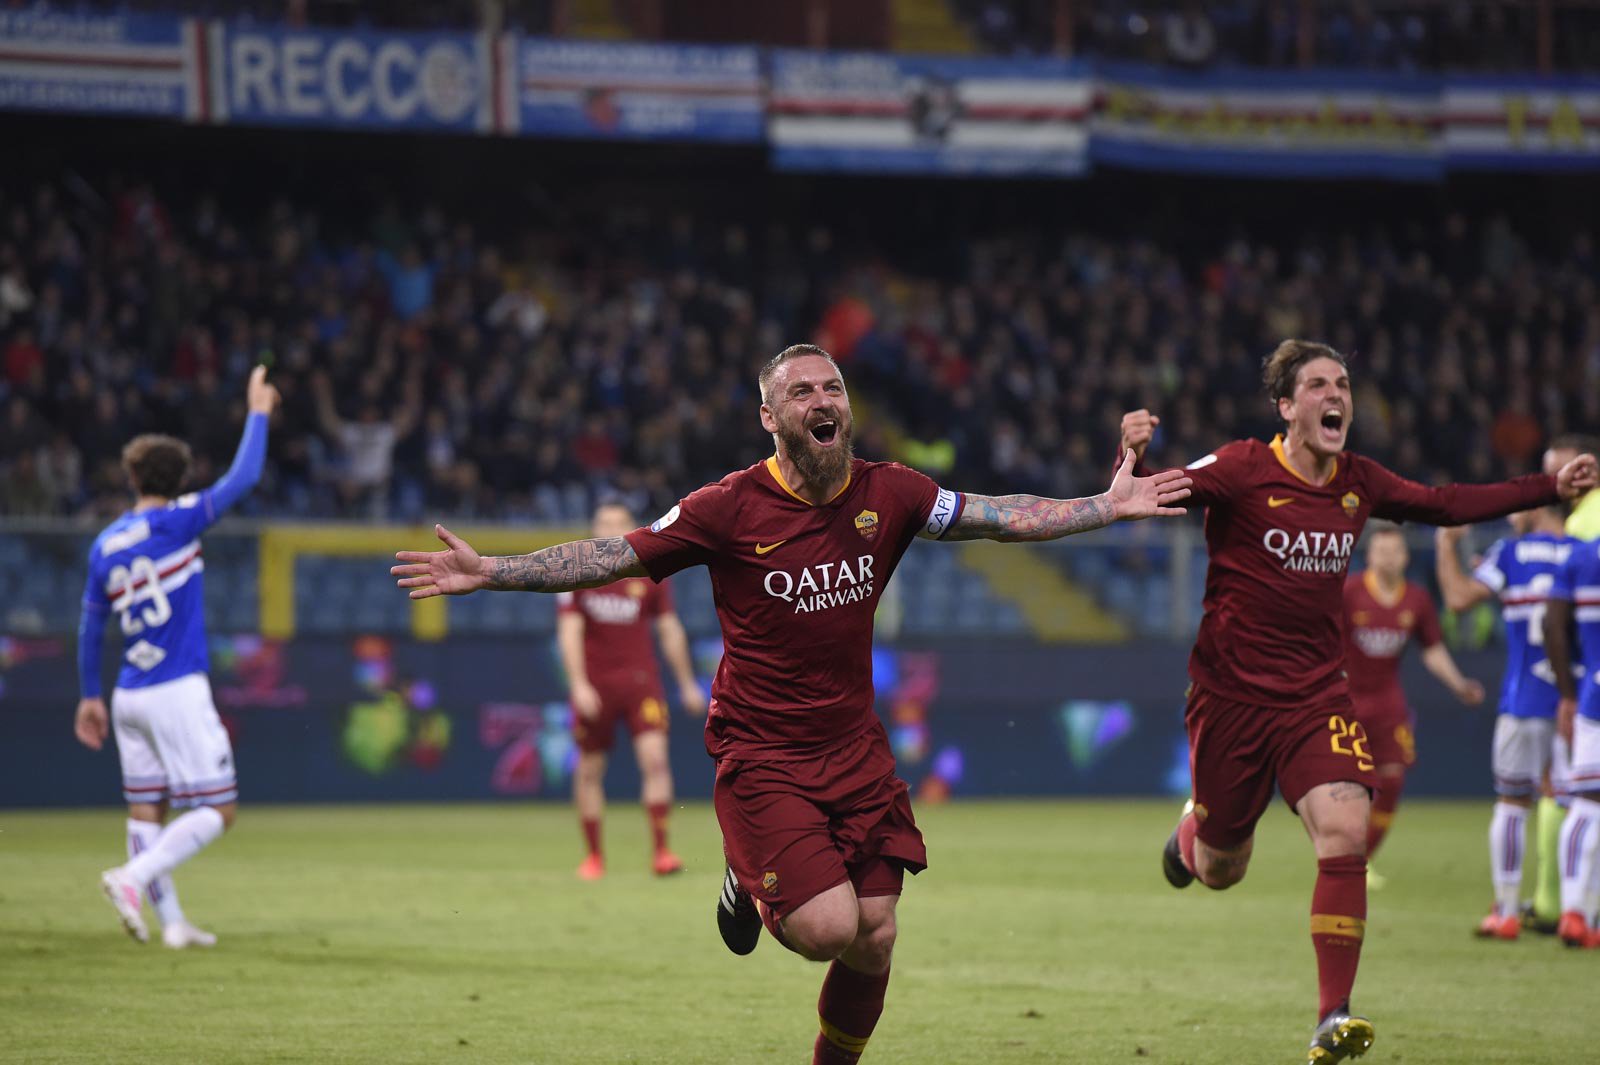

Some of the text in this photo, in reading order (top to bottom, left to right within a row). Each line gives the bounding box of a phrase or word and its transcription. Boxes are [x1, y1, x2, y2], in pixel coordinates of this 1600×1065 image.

[231, 34, 478, 124] RECCO
[1263, 528, 1354, 559] QATAR
[107, 557, 171, 635] 23
[763, 554, 874, 602] QATAR
[794, 580, 874, 614] AIRWAYS
